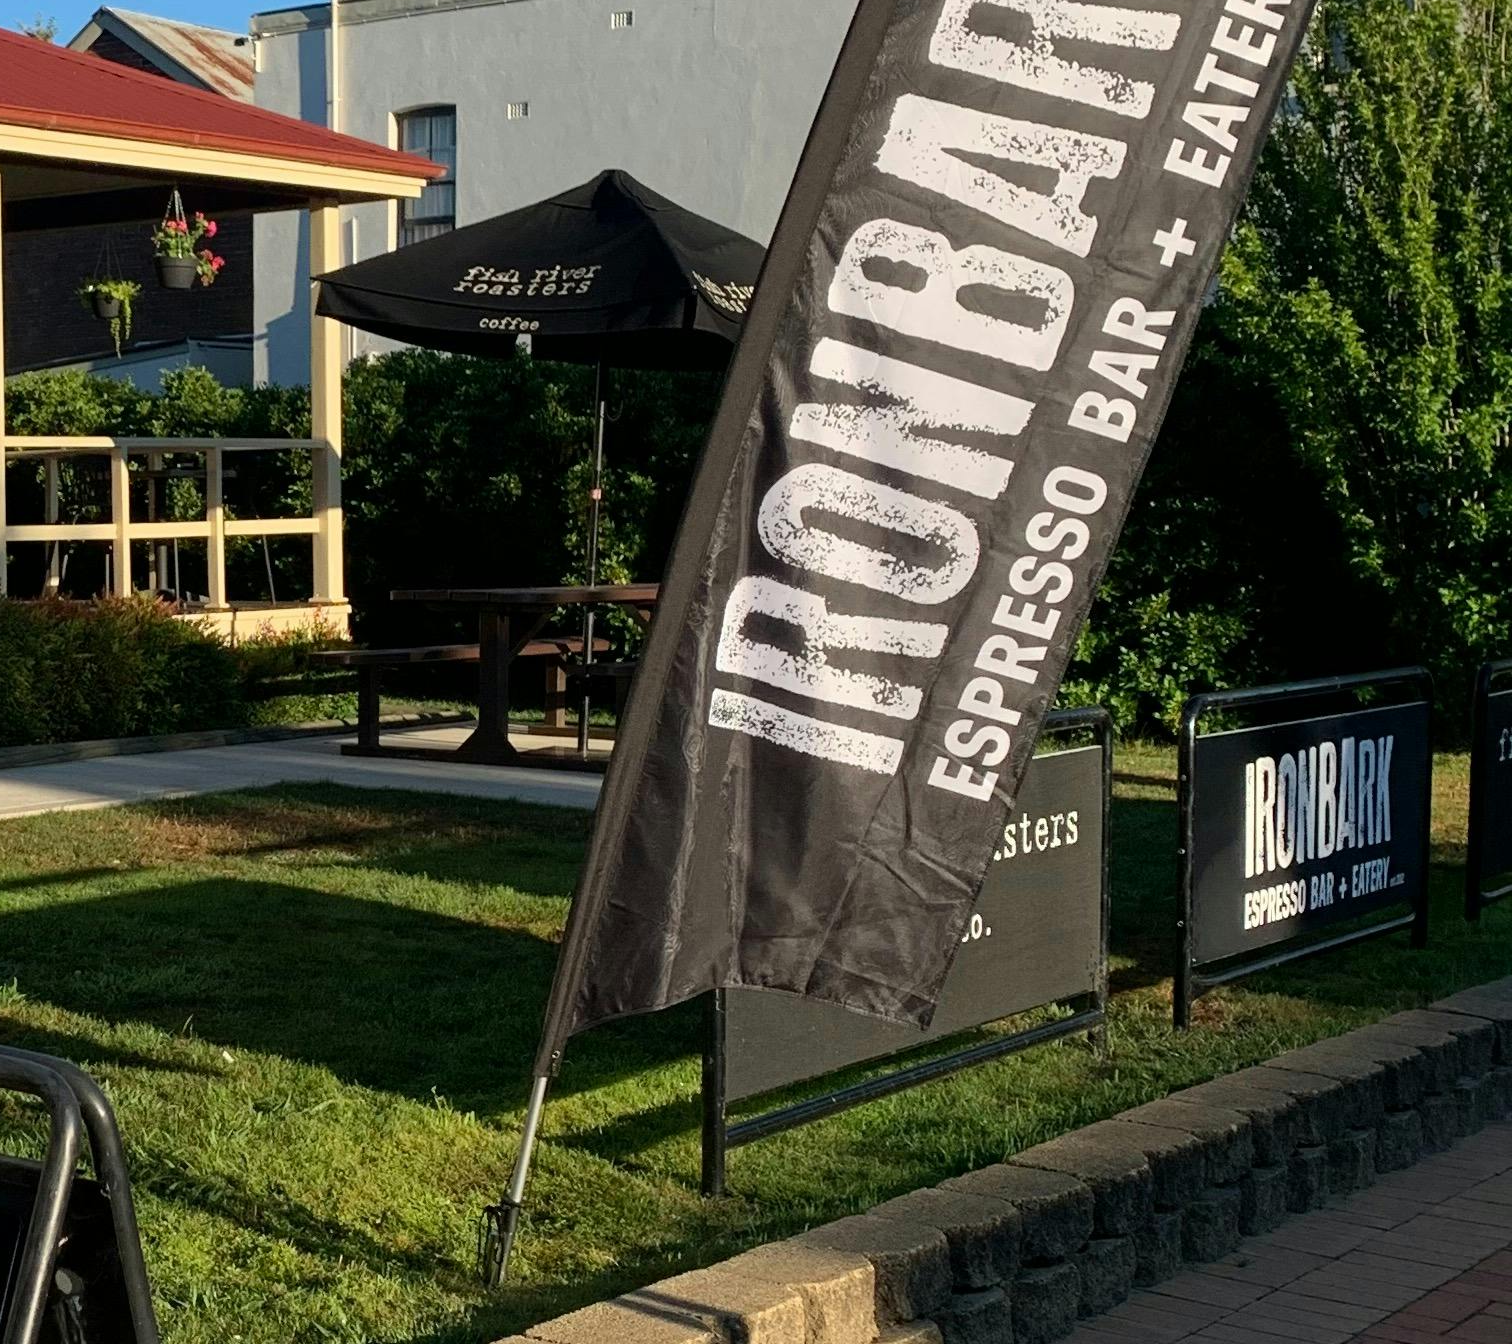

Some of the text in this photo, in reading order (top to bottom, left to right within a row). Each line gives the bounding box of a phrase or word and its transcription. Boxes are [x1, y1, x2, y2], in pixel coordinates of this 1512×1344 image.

[453, 280, 591, 296] roasters
[531, 264, 602, 283] river
[479, 316, 540, 331] coffee
[927, 465, 1108, 802] ESPRESSO
[1069, 297, 1174, 444] BAR
[1158, 218, 1193, 268] +
[1244, 735, 1394, 879] IRONBARK
[993, 810, 1079, 861] sters
[1244, 856, 1391, 930] ESPRESSO BAR + EATERY
